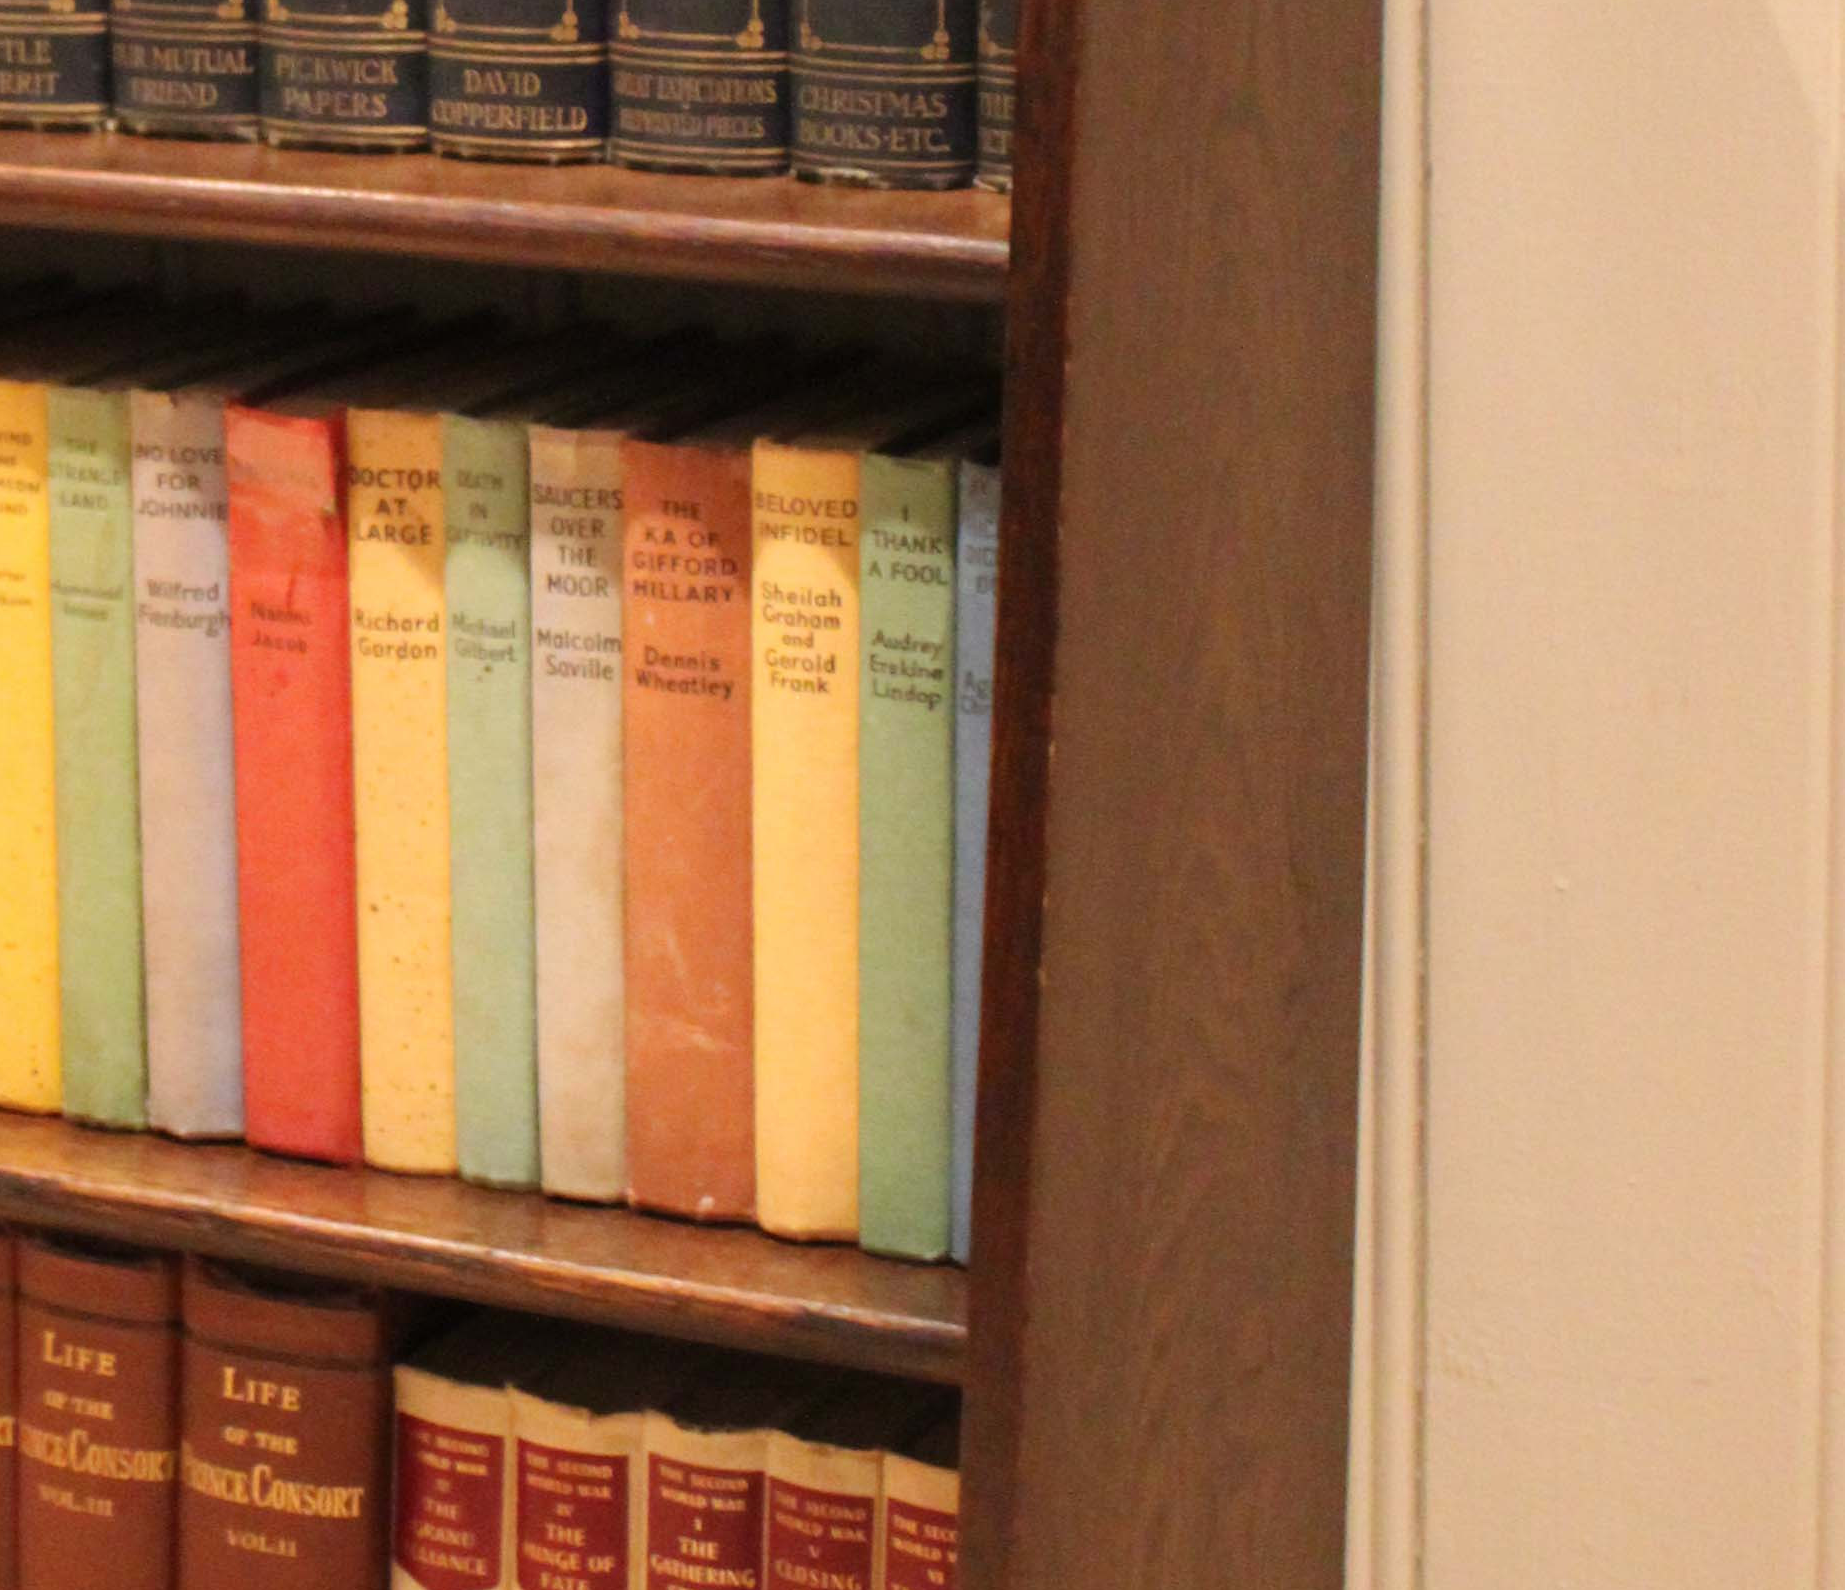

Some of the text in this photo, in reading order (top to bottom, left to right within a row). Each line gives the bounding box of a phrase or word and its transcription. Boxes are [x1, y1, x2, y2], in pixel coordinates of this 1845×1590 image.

[463, 68, 542, 98] DAVID
[798, 84, 948, 118] CHRISTMAS
[155, 472, 201, 492] FOR
[347, 464, 442, 491] DOCTOR
[373, 497, 408, 517] AT
[533, 482, 624, 511] SAUCERS
[661, 499, 702, 521] THE
[754, 490, 859, 520] BELOVED
[355, 523, 434, 547] LARGE
[549, 515, 606, 539] OVER
[687, 530, 720, 549] OF
[758, 521, 854, 547] INFIDEL
[872, 528, 944, 555] THANK
[557, 545, 597, 568] THE
[631, 549, 739, 577] GIFFORD
[546, 572, 610, 599] MOOR
[867, 560, 950, 586] A FOOL
[632, 579, 735, 604] HILLARY
[761, 580, 843, 609] Sheilah
[355, 607, 441, 633] Richard
[761, 604, 842, 631] Graham
[356, 636, 438, 661] Gordon
[536, 627, 622, 655] Malcolm
[781, 630, 815, 650] and
[870, 629, 944, 658] Audrey
[544, 653, 615, 681] Saville
[643, 645, 723, 673] Dennis
[764, 647, 837, 674] Gerold
[869, 653, 944, 681] Erskine
[635, 667, 736, 701] Wheatley
[769, 669, 831, 695] Frank
[871, 677, 943, 712] Lindop
[42, 1330, 117, 1377] LIFE
[223, 1366, 302, 1412] LIFE
[71, 1397, 115, 1421] THE
[223, 1424, 298, 1456] OF THE
[69, 1428, 175, 1484] CONSORT
[252, 1463, 366, 1520] CONSORT
[544, 1523, 587, 1548] THE
[677, 1535, 721, 1560] THE
[586, 1555, 616, 1575] OF
[649, 1551, 757, 1590] GATHERING
